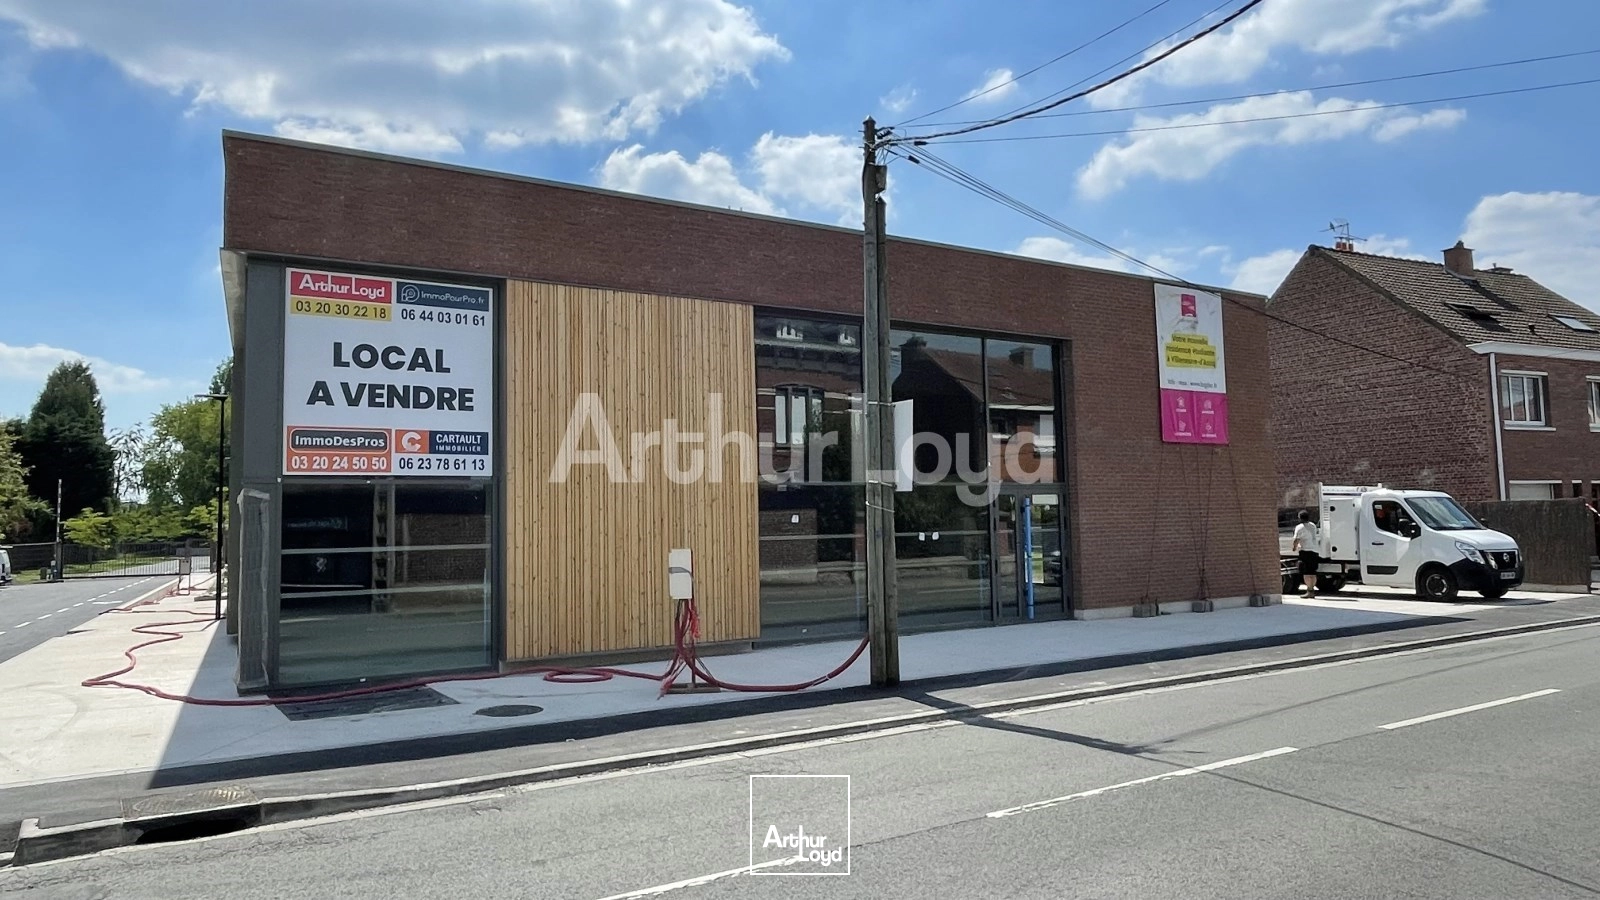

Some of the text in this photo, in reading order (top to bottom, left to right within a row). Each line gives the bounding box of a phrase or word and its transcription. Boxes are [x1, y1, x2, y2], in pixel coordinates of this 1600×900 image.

[299, 274, 385, 300] Arthur Loyd
[421, 291, 485, 304] ImmoPourPro.fr
[296, 300, 387, 318] 03 20 30 22 18
[401, 308, 485, 326] 06 44 03 01 61
[333, 342, 451, 373] LOCAL
[306, 381, 474, 411] A VENDRE
[295, 435, 385, 447] ImmoDesPros
[436, 434, 482, 444] CARTAULT
[291, 456, 387, 470] 03 20 24 50 50
[399, 457, 485, 470] 06 23 78 61 13
